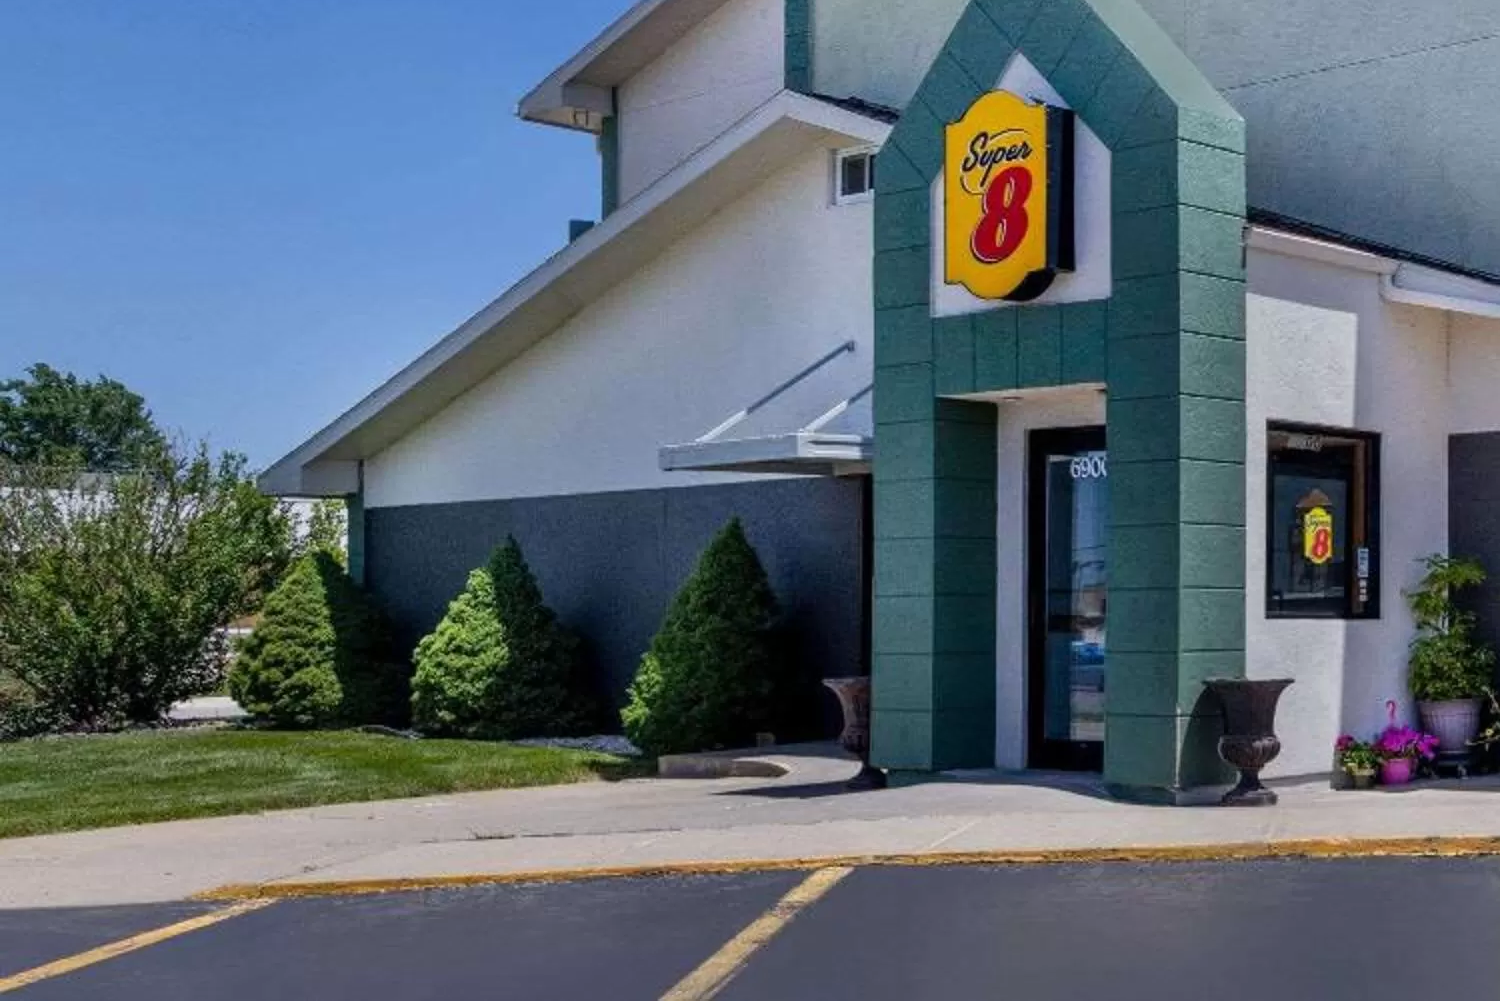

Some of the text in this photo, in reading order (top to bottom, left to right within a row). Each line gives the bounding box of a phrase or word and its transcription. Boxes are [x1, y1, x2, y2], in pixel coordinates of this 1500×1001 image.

[962, 131, 1033, 187] Super
[970, 166, 1033, 264] 8
[1312, 528, 1329, 559] 8
